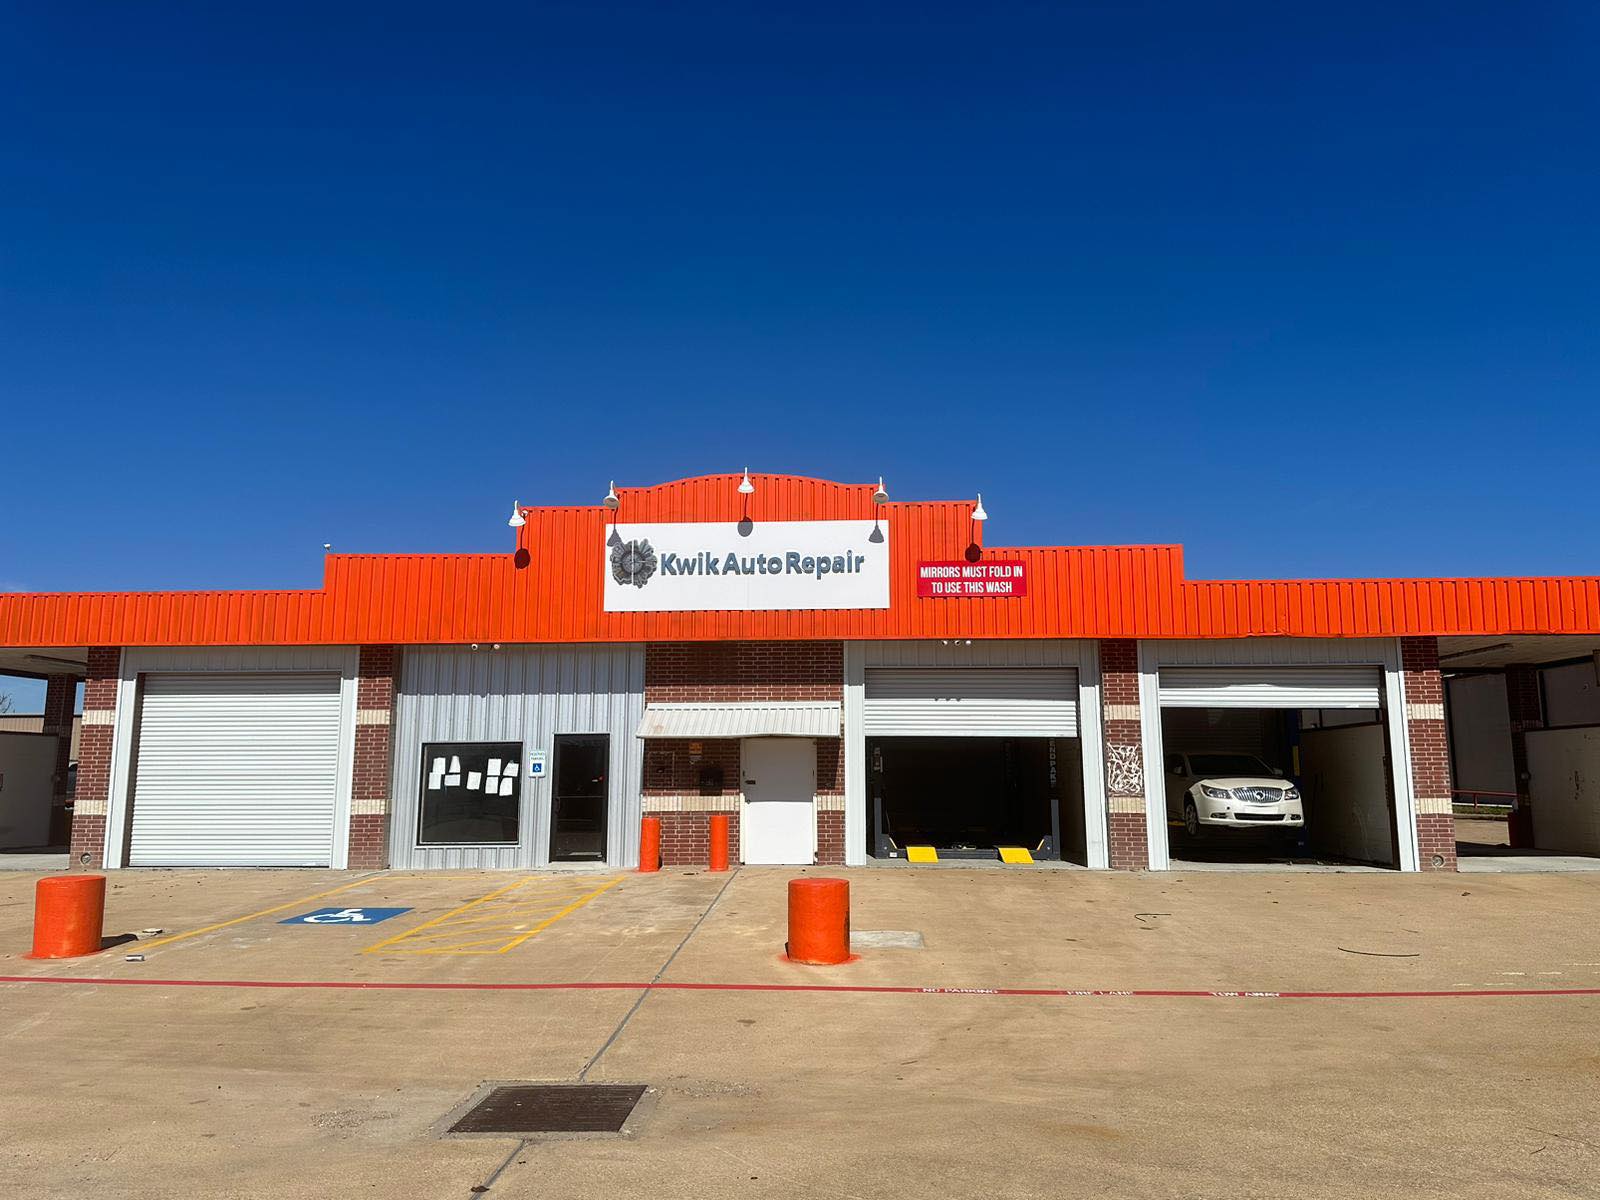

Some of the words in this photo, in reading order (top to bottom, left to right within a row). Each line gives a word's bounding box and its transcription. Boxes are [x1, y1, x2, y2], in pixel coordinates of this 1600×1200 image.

[661, 552, 719, 576] Kwik
[722, 552, 783, 575] Auto
[785, 549, 865, 580] Repair
[920, 566, 960, 578] MIRRORS
[962, 566, 987, 578] MUST
[989, 566, 1012, 577] FOLD
[1013, 565, 1023, 577] IN
[931, 582, 943, 593] TO
[944, 582, 962, 593] USE
[963, 581, 984, 593] THIS
[985, 581, 1012, 593] WASH
